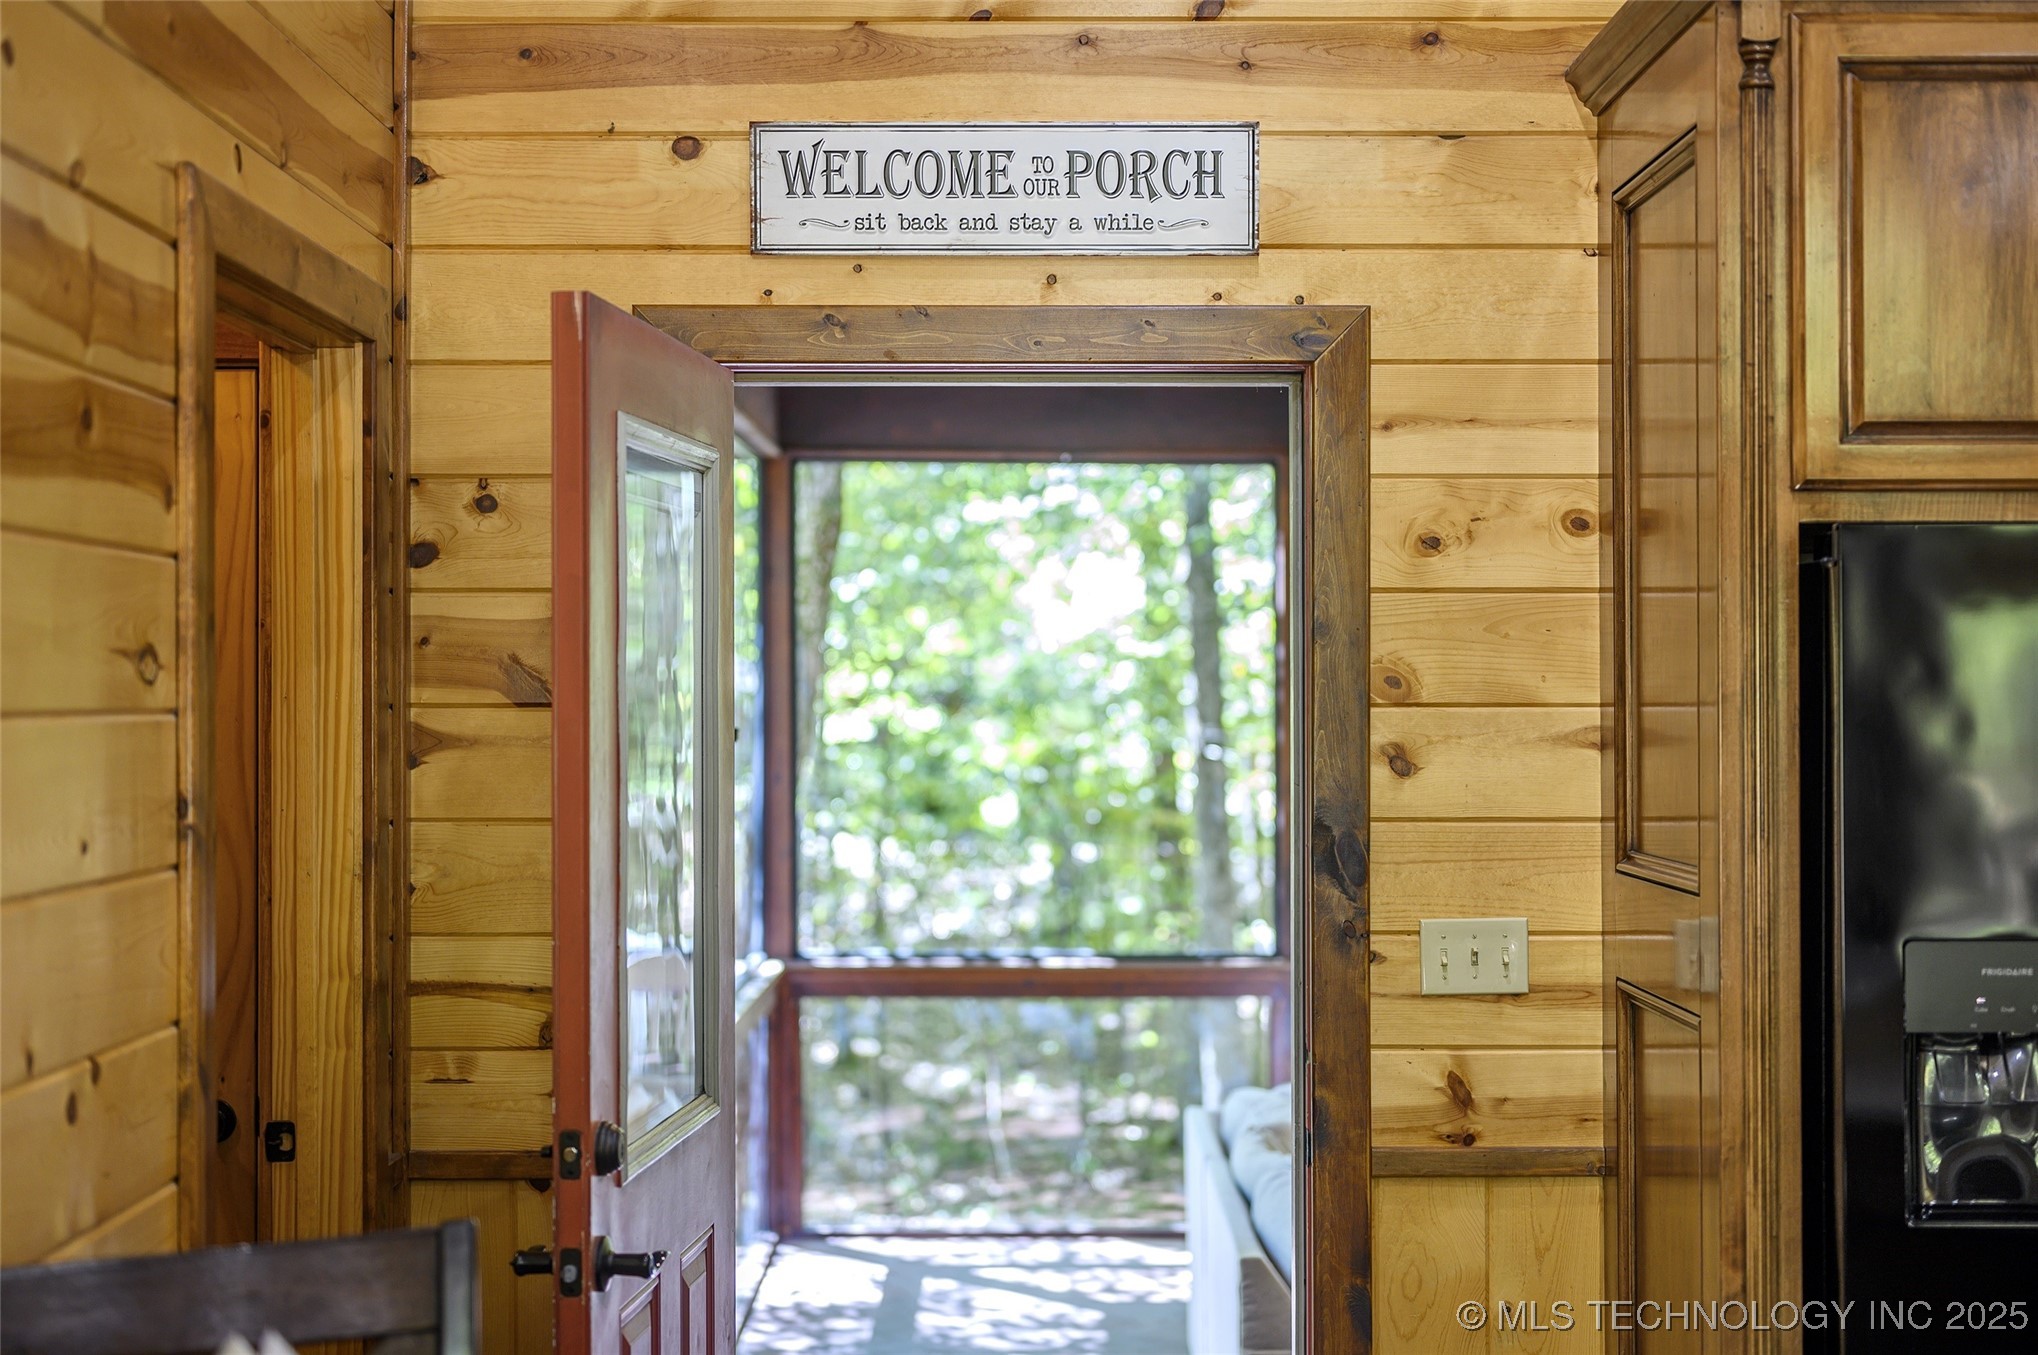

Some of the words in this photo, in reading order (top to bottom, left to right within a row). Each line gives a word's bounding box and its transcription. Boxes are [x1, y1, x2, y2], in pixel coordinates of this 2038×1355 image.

[778, 138, 1018, 199] WELCOME
[1031, 156, 1055, 174] TO
[1064, 149, 1225, 203] PORCH
[1023, 178, 1061, 196] OUR
[854, 212, 887, 231] sit
[898, 212, 948, 231] back
[959, 212, 998, 231] and
[1009, 212, 1058, 235] stay
[1069, 217, 1083, 231] a
[1094, 212, 1154, 231] while
[1981, 967, 2034, 976] FRIGIDAIRE
